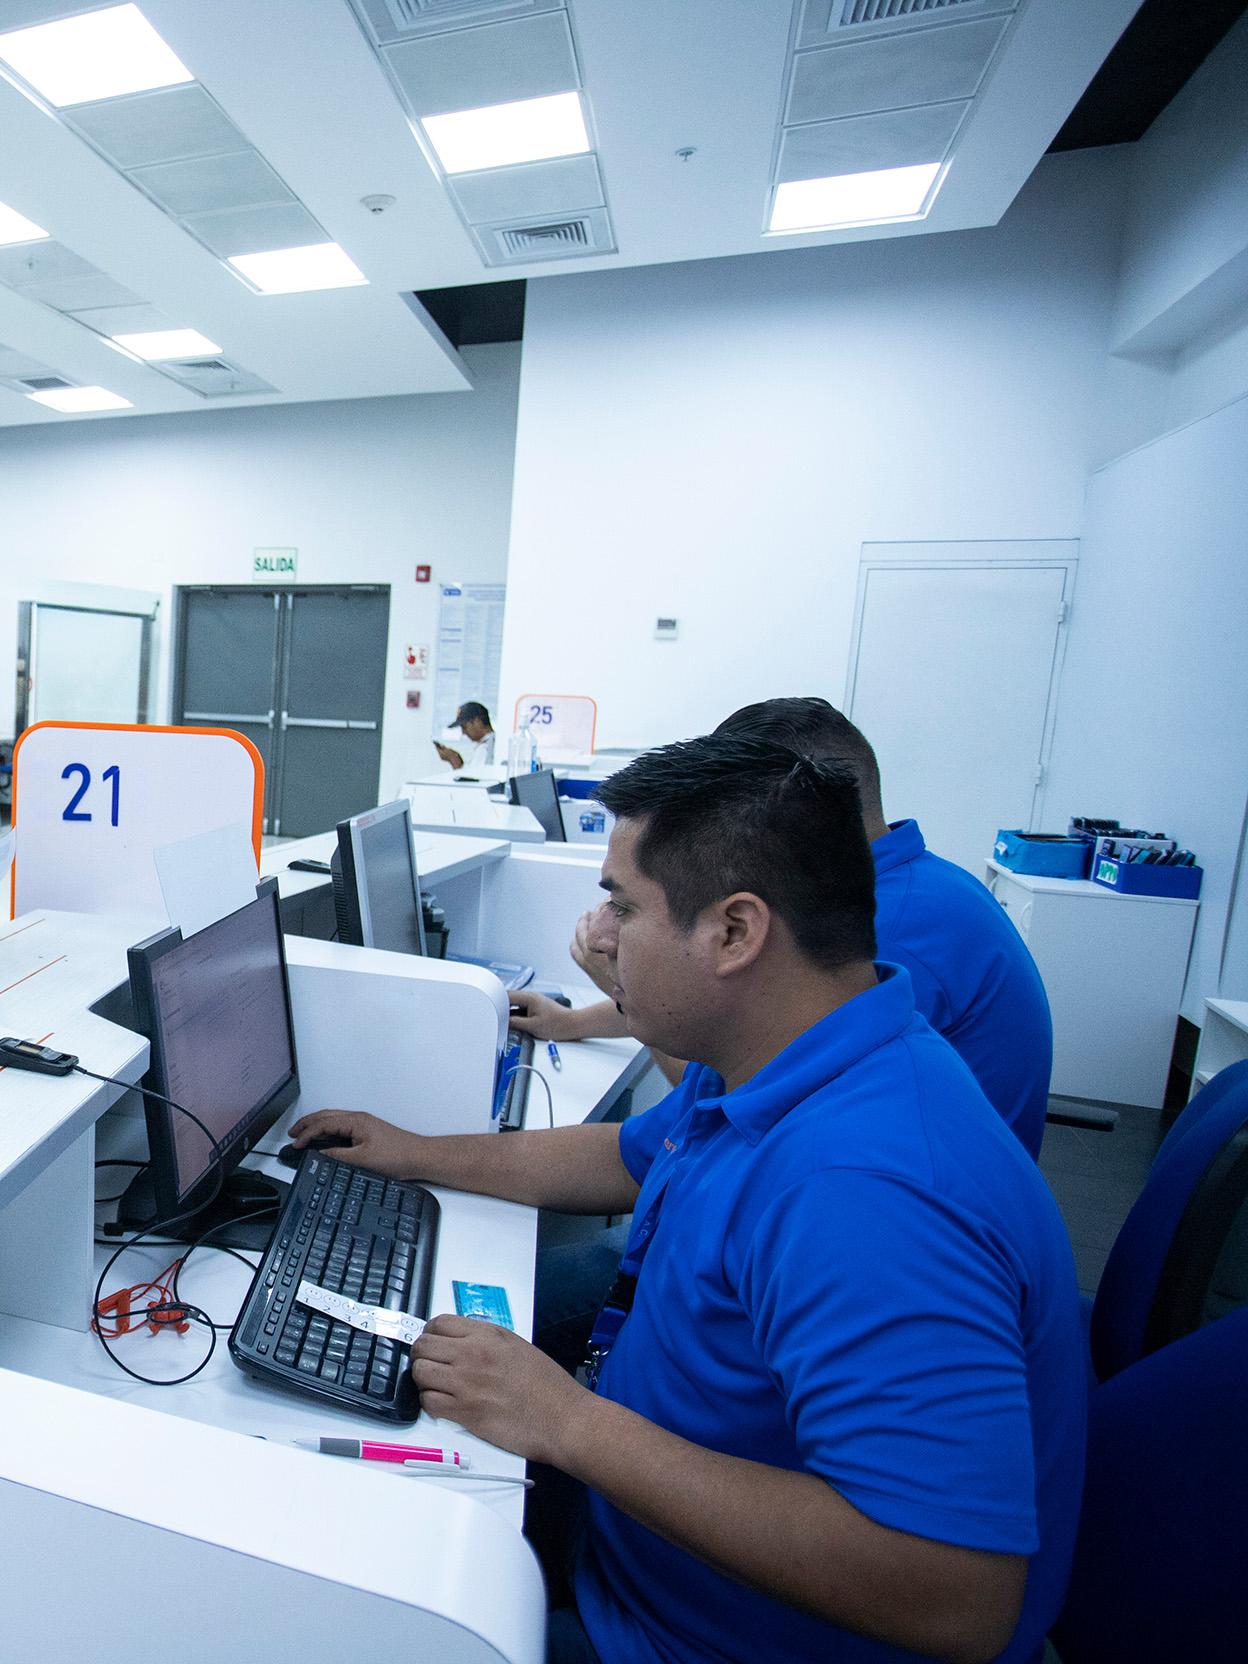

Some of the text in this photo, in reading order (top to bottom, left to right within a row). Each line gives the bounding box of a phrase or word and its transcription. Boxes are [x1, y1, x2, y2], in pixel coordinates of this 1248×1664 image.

[254, 557, 295, 572] SALIDA
[529, 704, 554, 725] 25
[60, 762, 121, 827] 21
[322, 1305, 331, 1313] 2
[344, 1314, 352, 1323] 3
[360, 1321, 369, 1329] 4
[404, 1333, 413, 1342] 6
